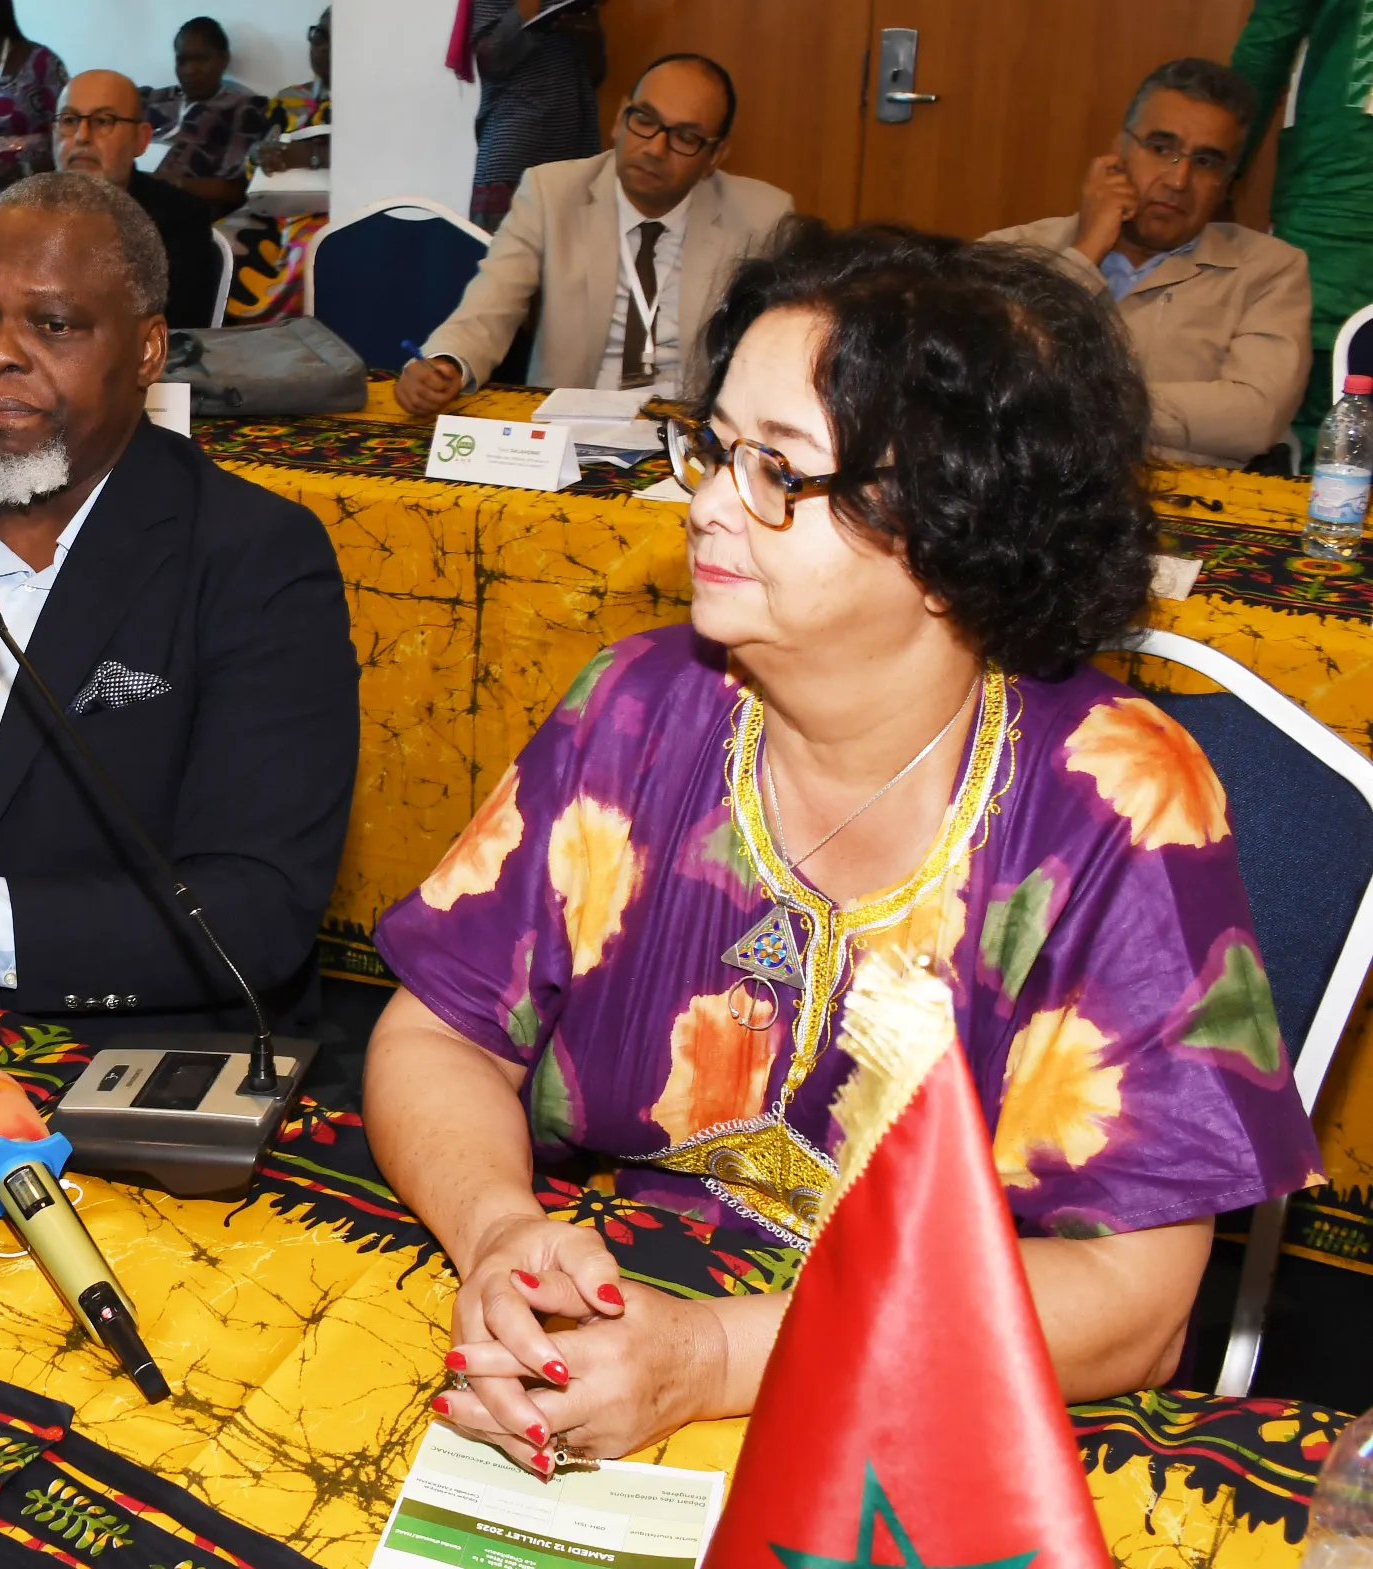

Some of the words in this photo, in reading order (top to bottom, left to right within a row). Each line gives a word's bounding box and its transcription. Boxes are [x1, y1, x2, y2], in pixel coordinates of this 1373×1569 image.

[437, 433, 476, 462] 30
[430, 1445, 491, 1465] d'accueil/HAAC
[610, 1490, 659, 1502] délégations
[661, 1490, 707, 1501] étrangères
[676, 1498, 706, 1508] Départ
[475, 1522, 505, 1536] 2025
[629, 1530, 673, 1540] touristique
[505, 1531, 553, 1548] JUILLET
[674, 1535, 698, 1543] Sortie
[553, 1542, 566, 1552] 12
[567, 1545, 616, 1562] SAMEDI
